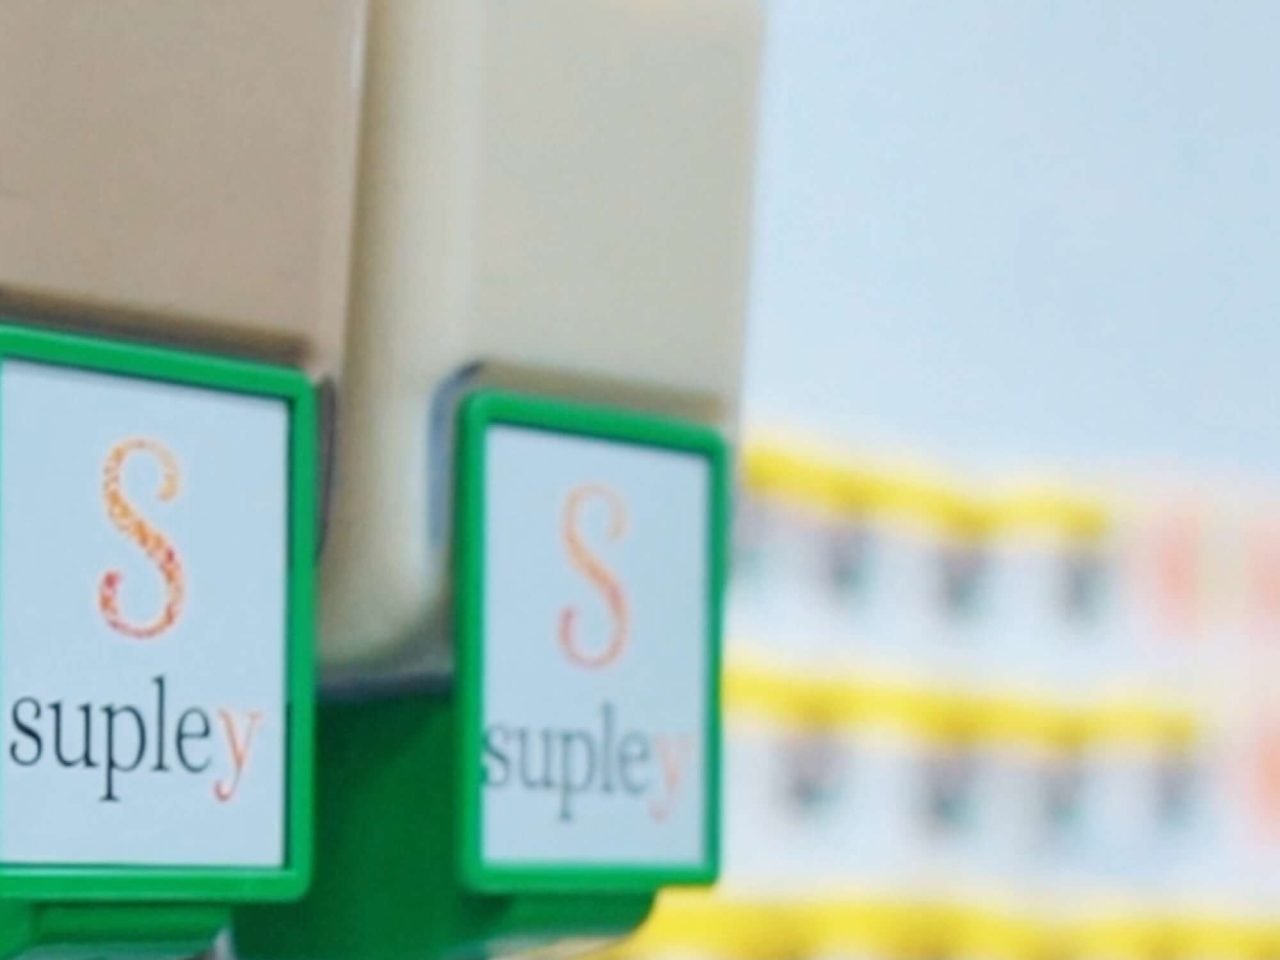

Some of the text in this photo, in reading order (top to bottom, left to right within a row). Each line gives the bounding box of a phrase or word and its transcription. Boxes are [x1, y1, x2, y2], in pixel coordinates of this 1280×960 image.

[99, 438, 183, 640] S
[557, 483, 631, 670] S
[9, 675, 262, 803] supley
[480, 701, 692, 824] supley
